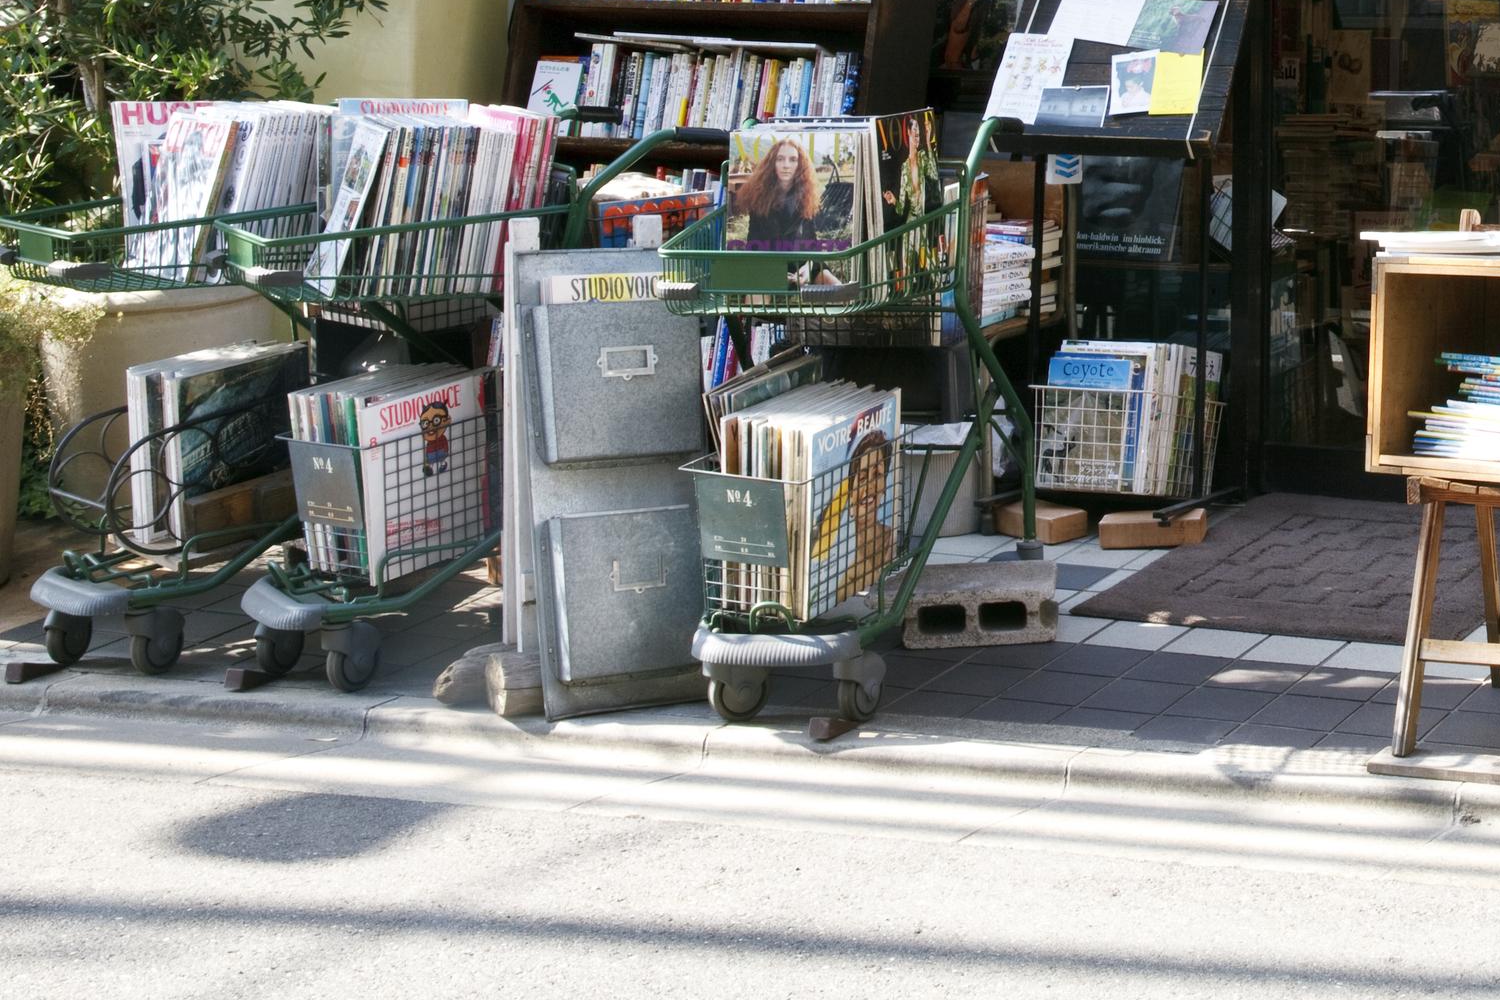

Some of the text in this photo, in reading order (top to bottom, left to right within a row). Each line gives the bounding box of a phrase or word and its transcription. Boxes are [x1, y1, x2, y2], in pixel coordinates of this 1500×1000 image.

[121, 102, 213, 126] HUG
[734, 132, 854, 164] VOUE
[1122, 233, 1133, 241] im
[1133, 233, 1166, 245] hinblick:
[1127, 244, 1162, 255] albtraum
[1063, 361, 1114, 383] Coyote
[817, 401, 893, 457] VOTRE BEAUTÉ
[324, 457, 334, 474] 4
[742, 490, 753, 508] 4
